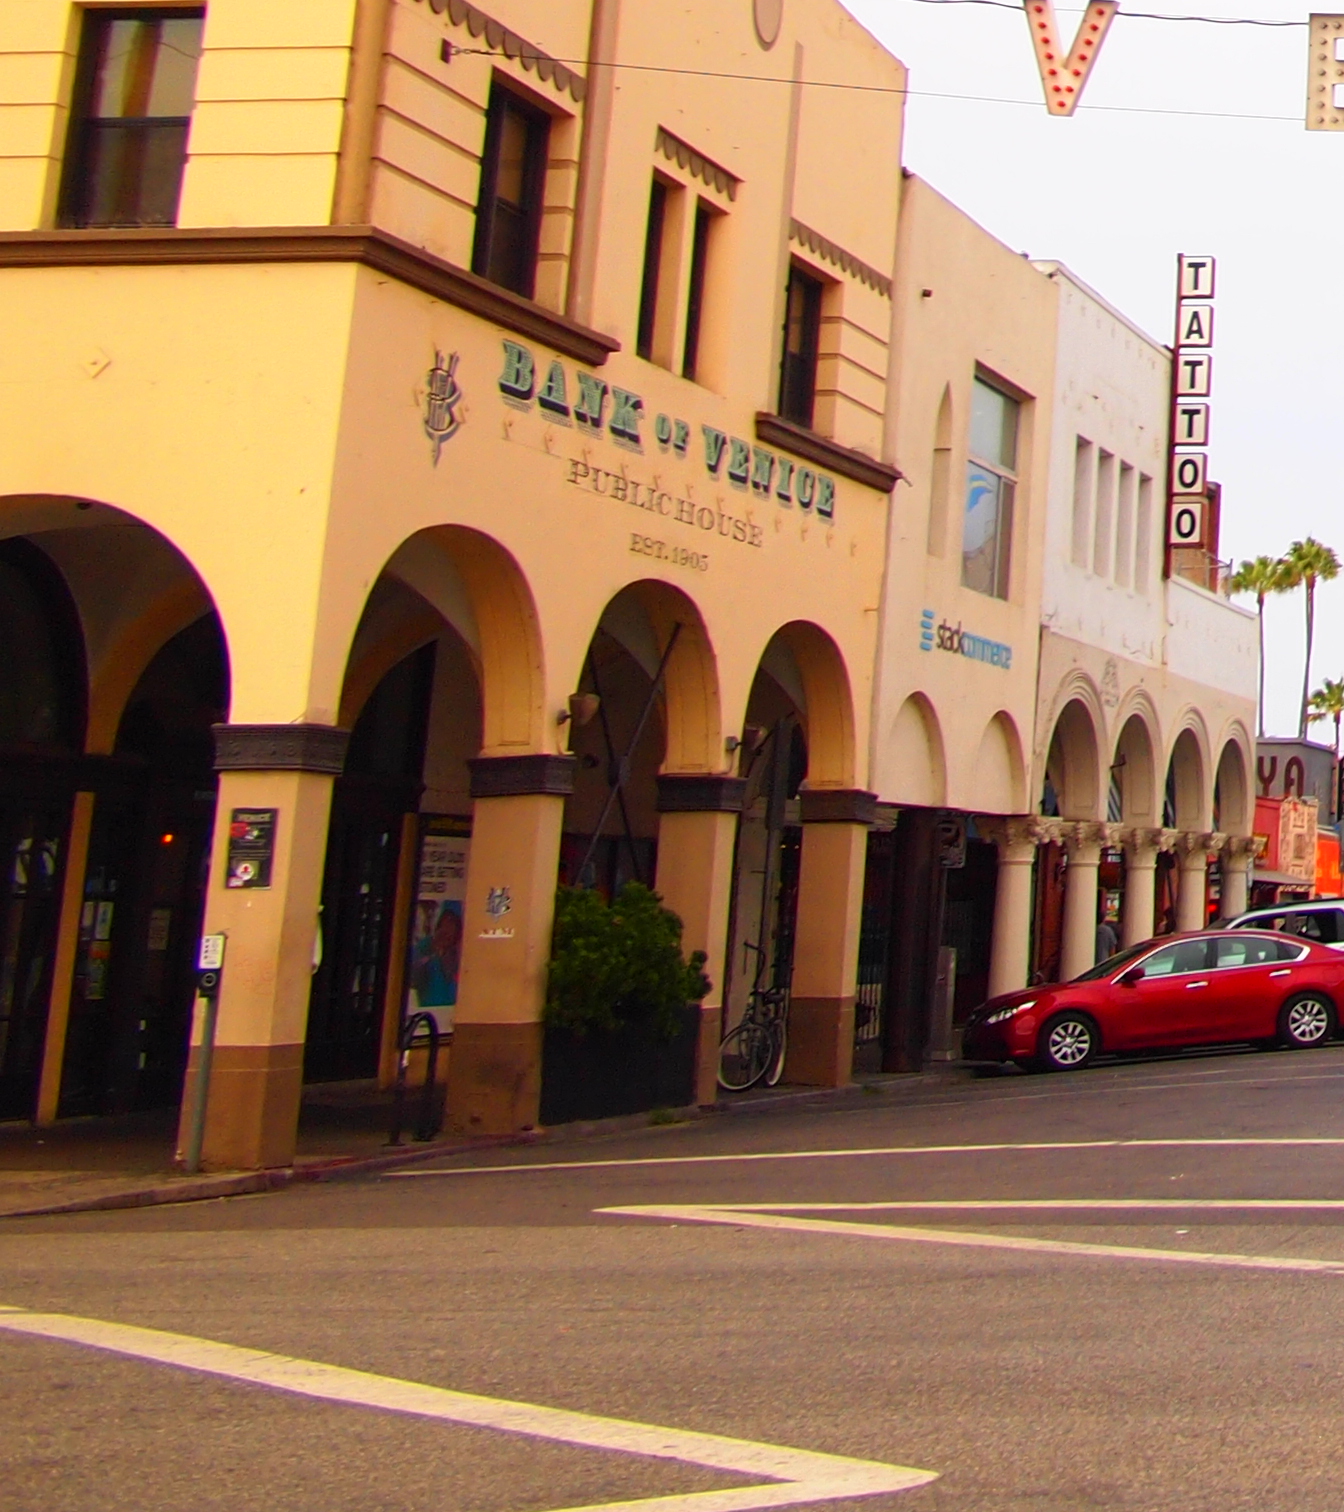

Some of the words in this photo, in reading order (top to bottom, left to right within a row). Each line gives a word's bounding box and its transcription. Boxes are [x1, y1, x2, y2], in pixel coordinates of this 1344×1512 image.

[499, 339, 645, 448] BANK
[655, 412, 691, 454] OF
[702, 423, 837, 520] VENICE
[1174, 260, 1208, 540] TATTOO
[567, 458, 676, 517] PUBLIC
[673, 497, 764, 548] HOUSE
